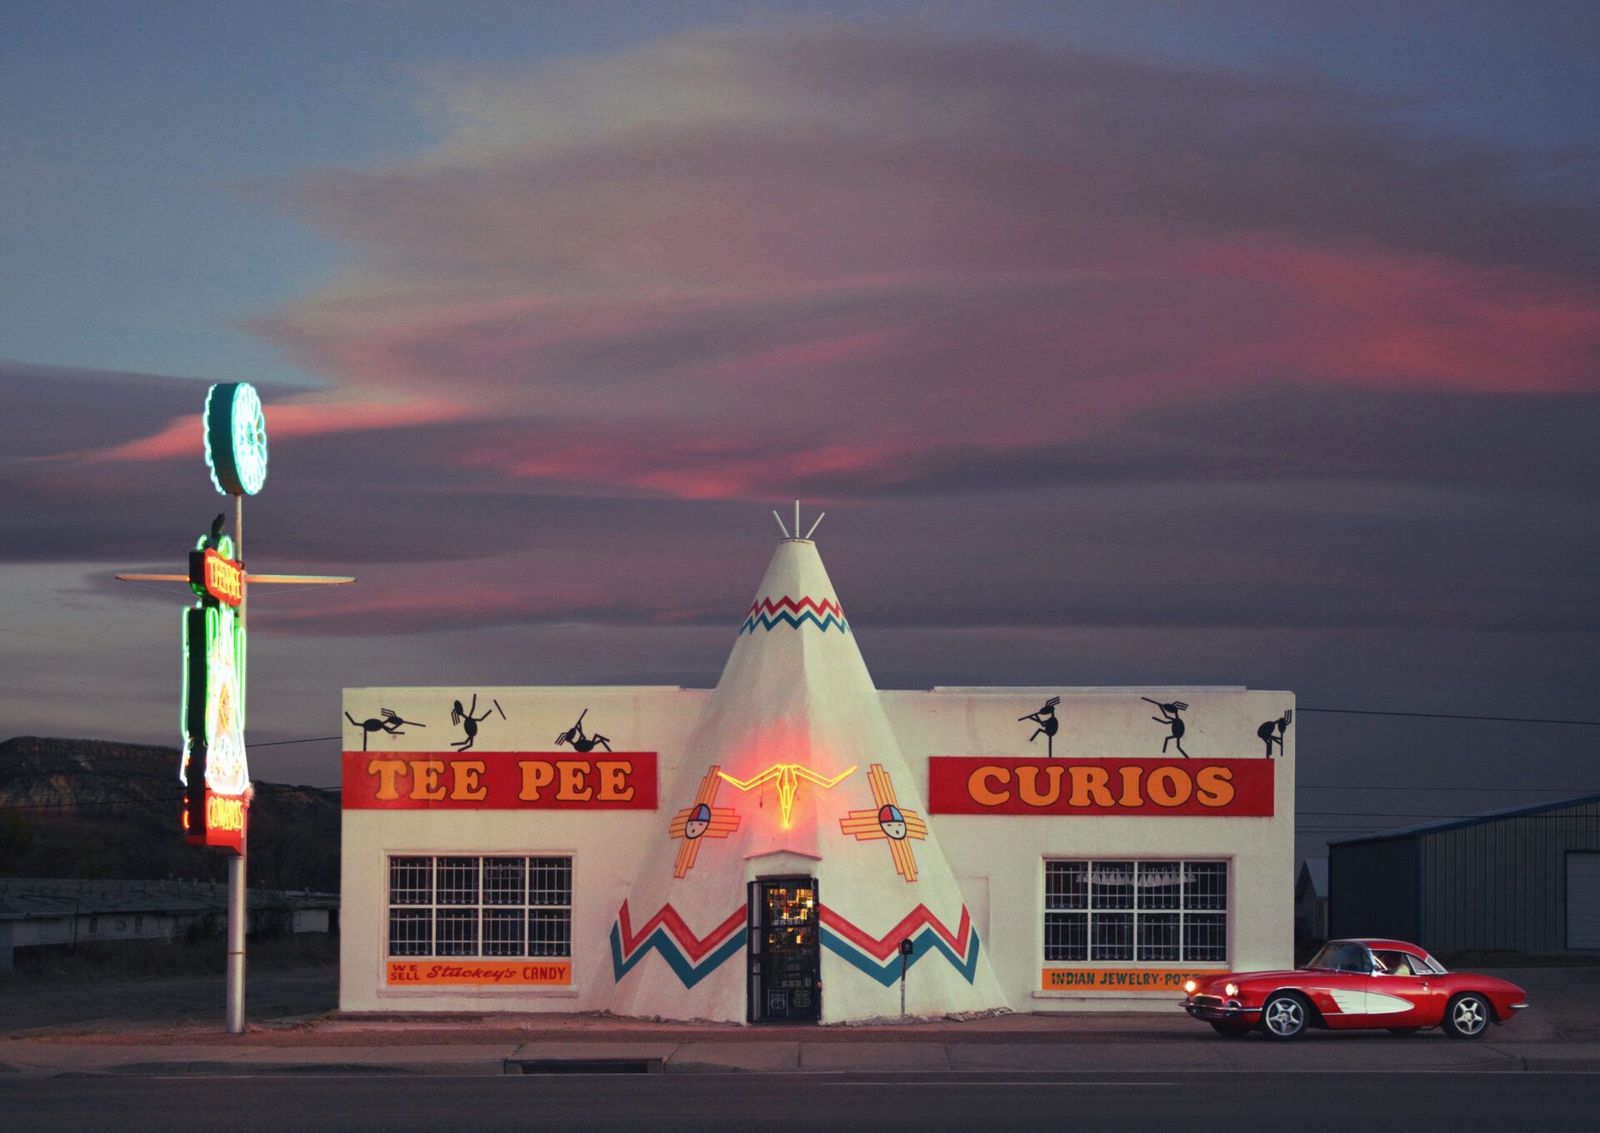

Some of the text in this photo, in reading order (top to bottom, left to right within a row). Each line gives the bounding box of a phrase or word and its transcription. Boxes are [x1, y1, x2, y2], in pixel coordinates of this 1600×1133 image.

[368, 759, 635, 802] TEE PEE
[967, 765, 1236, 808] CURIOS
[390, 972, 419, 981] SELL
[522, 967, 566, 980] CANDY
[1051, 972, 1095, 985] INDIAN
